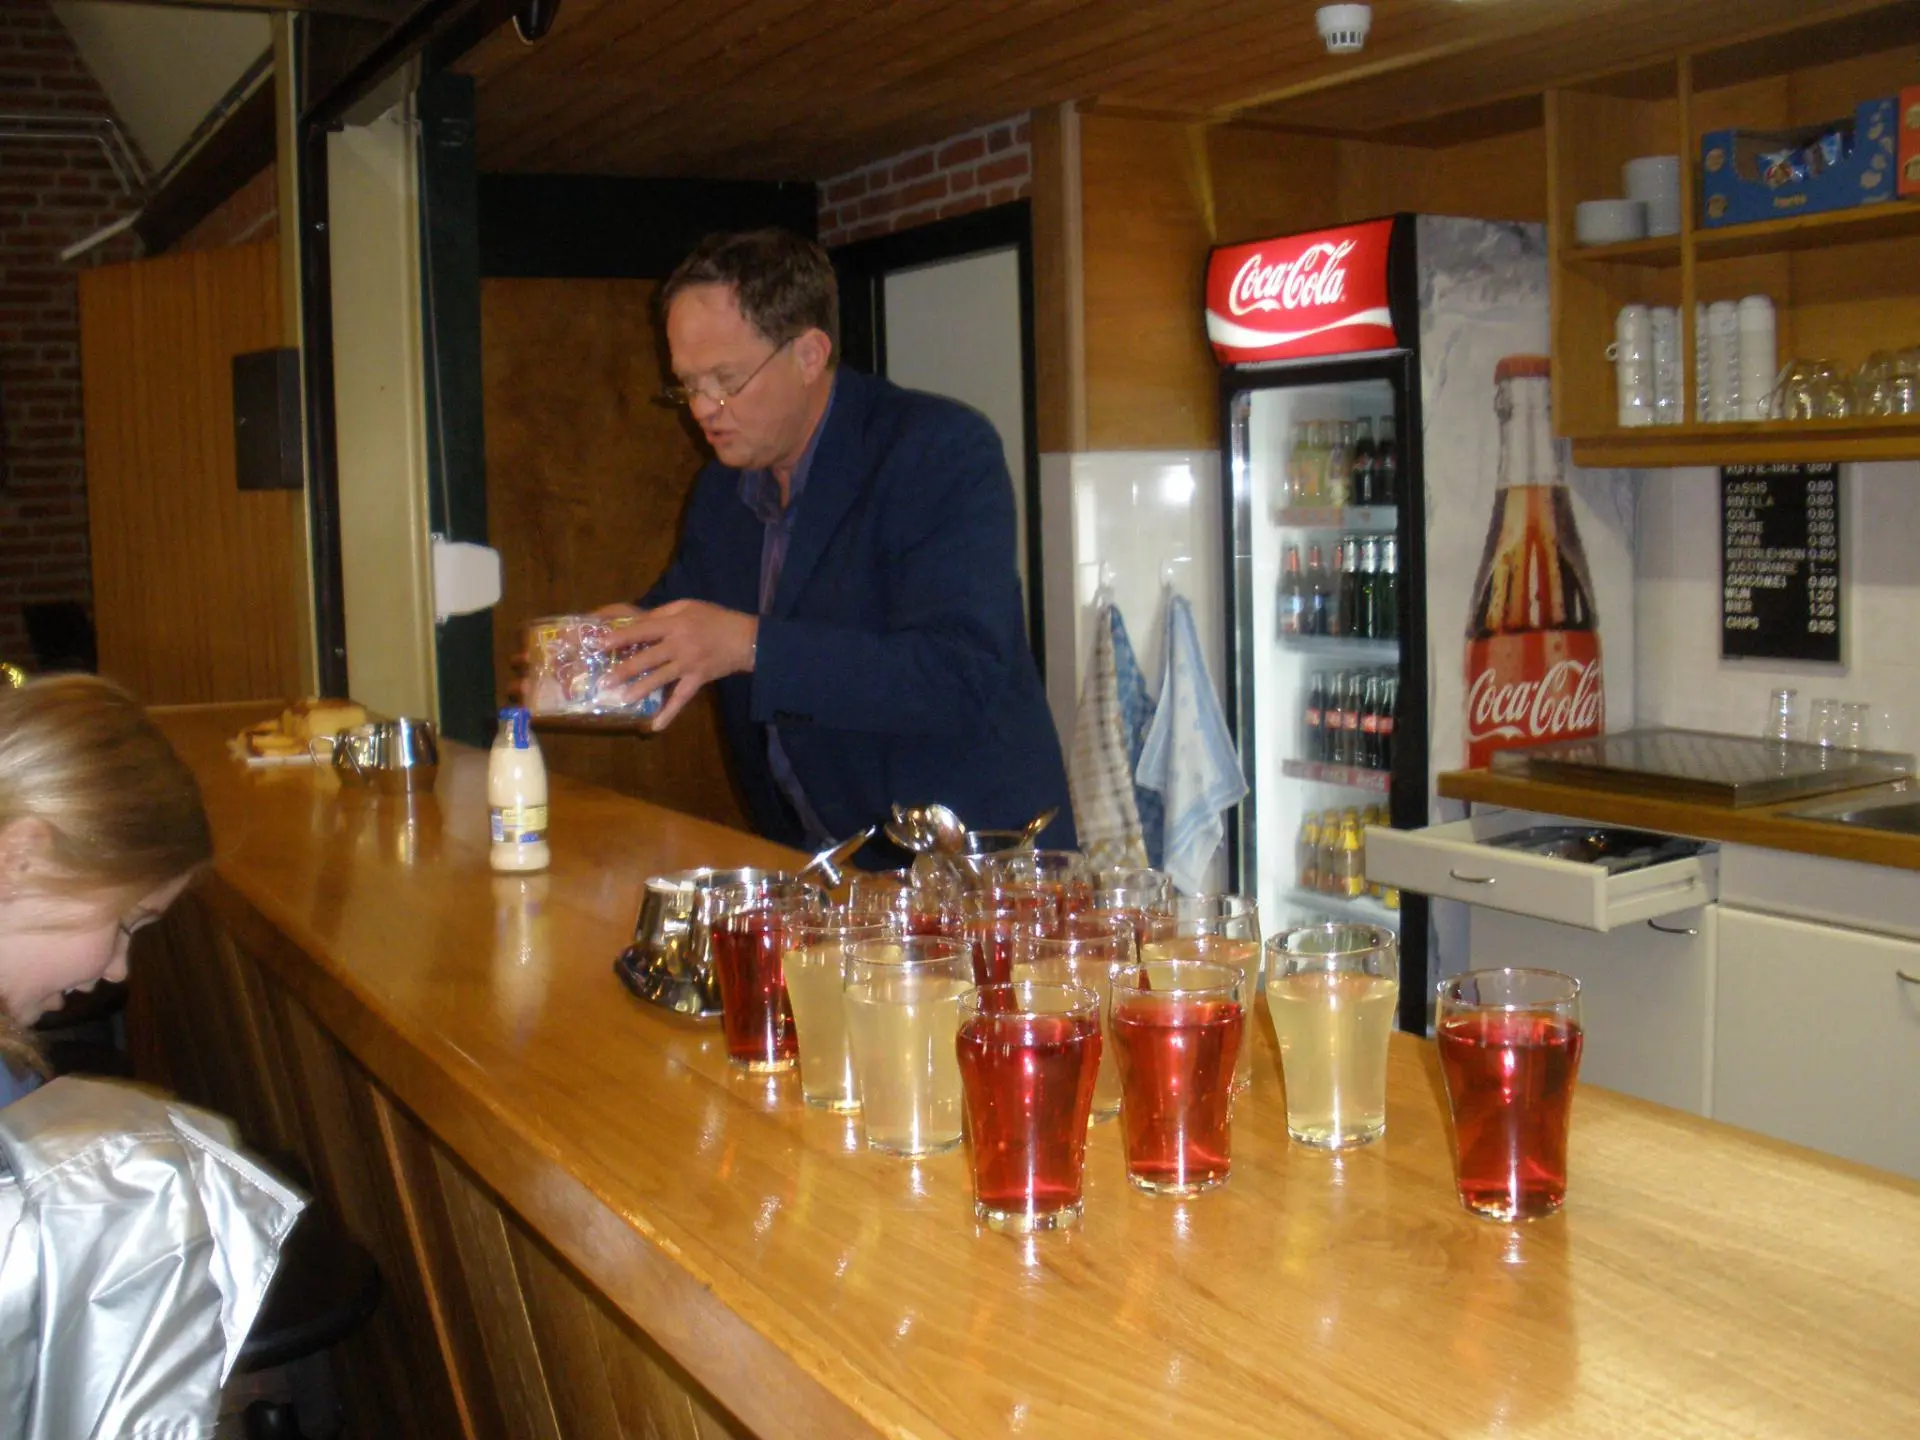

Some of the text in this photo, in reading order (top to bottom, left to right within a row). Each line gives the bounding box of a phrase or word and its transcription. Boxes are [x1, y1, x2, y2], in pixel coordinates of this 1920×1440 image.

[1229, 239, 1357, 316] Coca-Cola
[1727, 481, 1767, 494] CASSIS
[1727, 508, 1756, 521] COLA
[1727, 521, 1764, 535] SPRITE
[1727, 534, 1761, 547] FANTA
[1725, 615, 1760, 630] CHIPS
[1468, 659, 1600, 742] Coca-Cola
